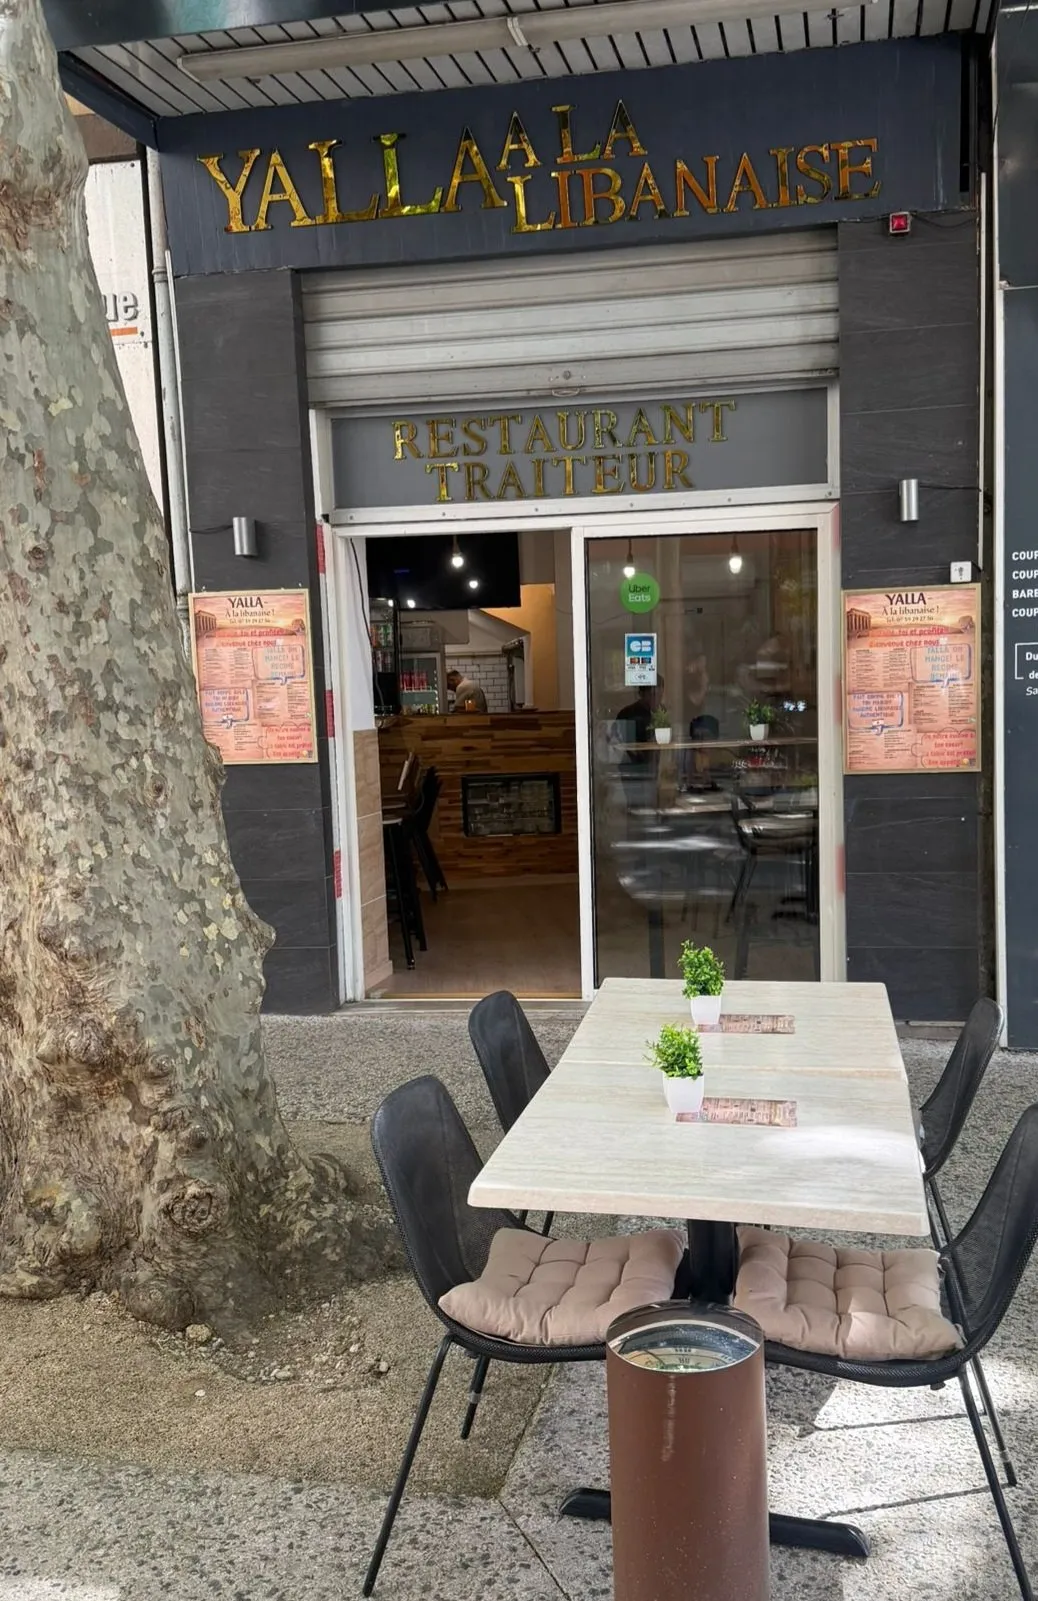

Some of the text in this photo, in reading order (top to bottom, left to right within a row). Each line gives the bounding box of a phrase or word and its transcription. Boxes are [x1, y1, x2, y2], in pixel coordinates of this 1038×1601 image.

[551, 99, 648, 164] LA
[197, 126, 508, 233] YALLA
[506, 136, 882, 235] LIBANAISE
[391, 400, 737, 461] RESTAURANT
[425, 449, 694, 502] TRAITEUR
[228, 597, 263, 608] YALLA
[628, 585, 651, 593] Uber
[628, 593, 651, 602] Eats
[885, 592, 926, 605] YALLA
[890, 606, 897, 615] la
[899, 605, 935, 615] libanaise
